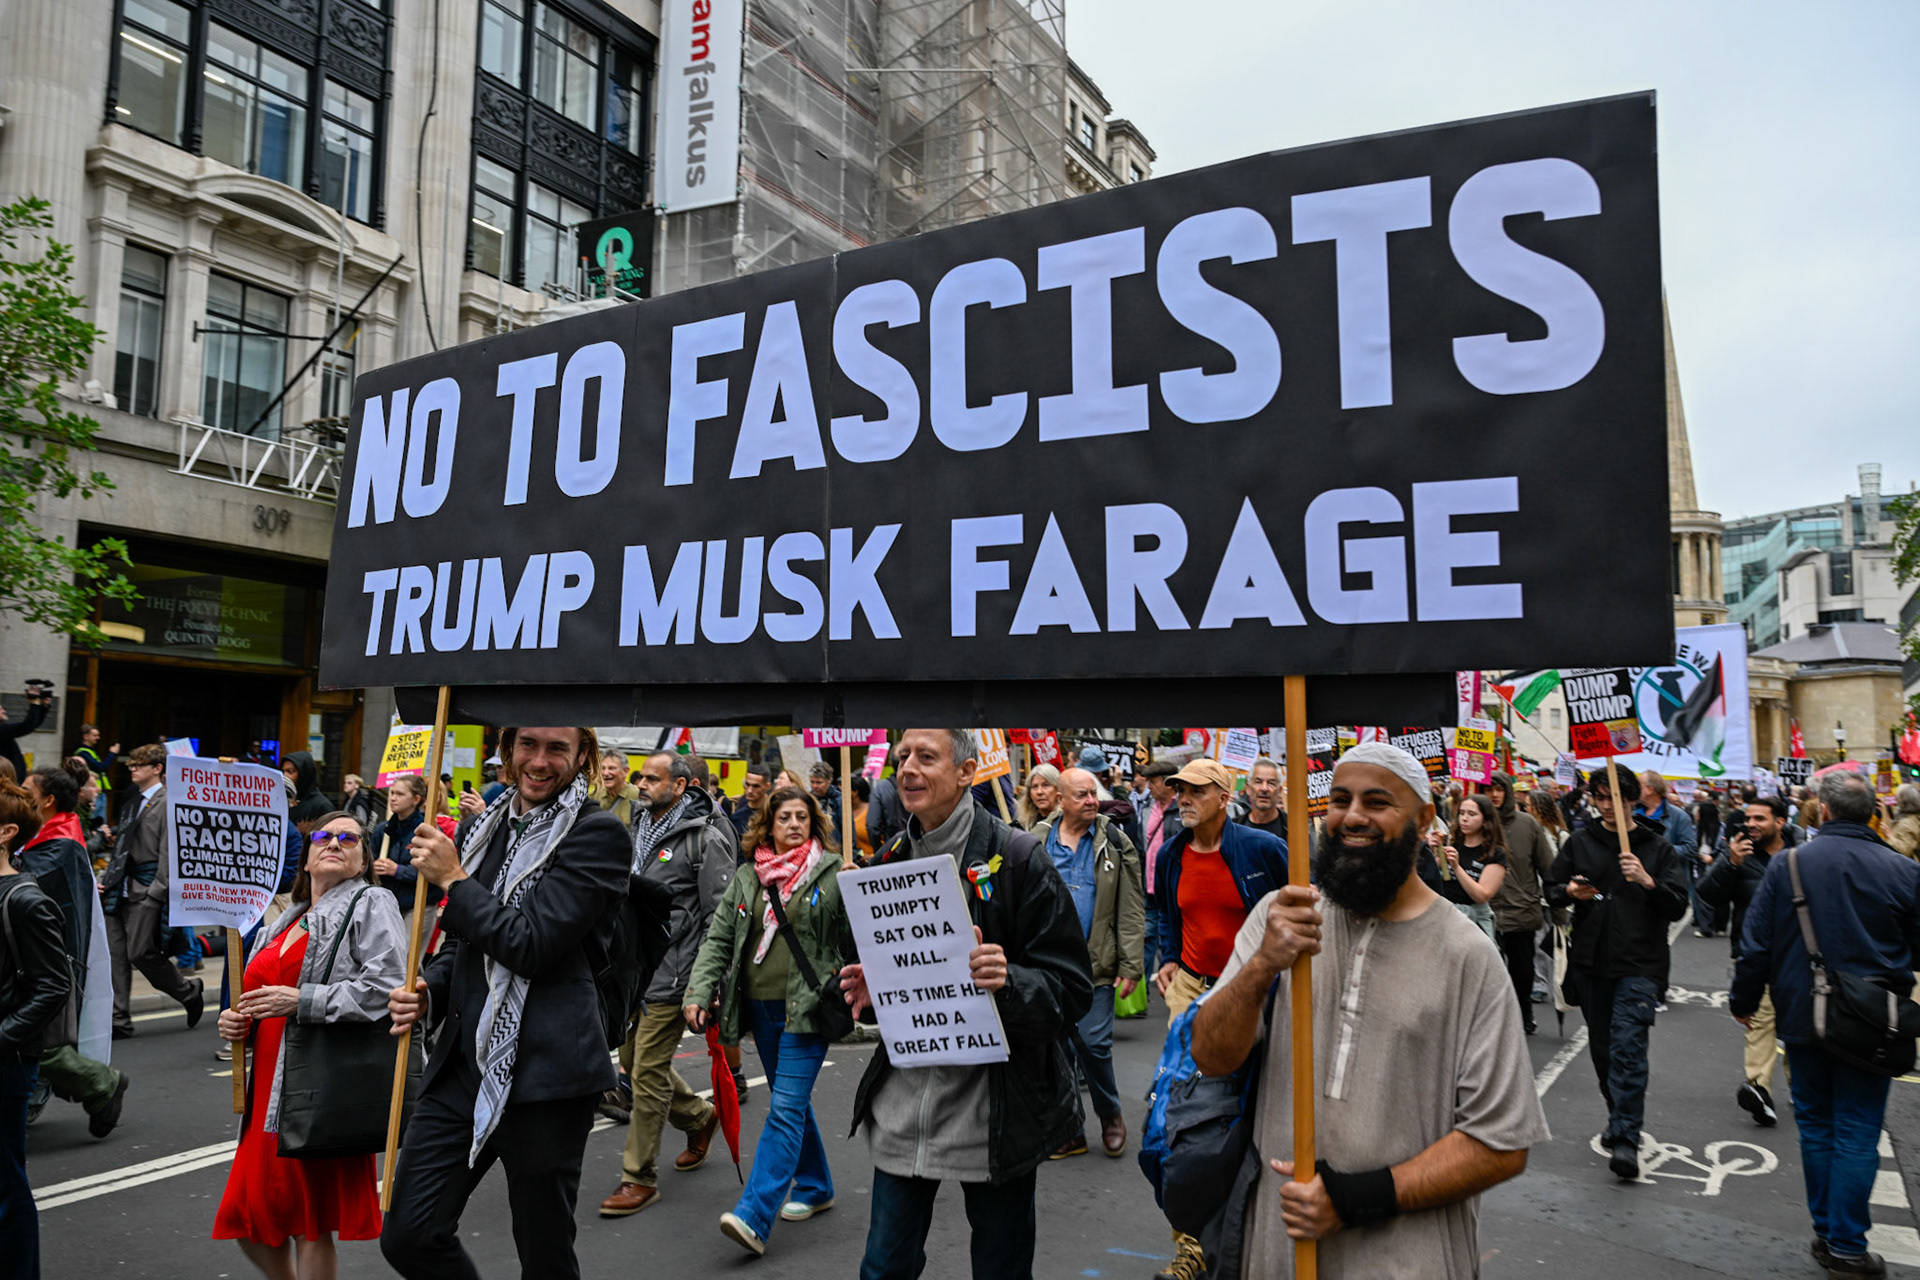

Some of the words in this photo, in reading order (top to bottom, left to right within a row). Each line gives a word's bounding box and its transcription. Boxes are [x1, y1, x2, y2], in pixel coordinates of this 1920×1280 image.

[348, 378, 460, 528] NO
[497, 341, 625, 505] TO
[664, 158, 1604, 487] FASCISTS
[253, 504, 290, 535] 309
[363, 550, 594, 656] TRUMP
[619, 524, 902, 646] MUSK
[951, 477, 1522, 636] FARAGE
[146, 595, 175, 612] THE
[178, 599, 273, 622] POLYTECHNIC
[164, 629, 216, 644] QUINTIN
[217, 635, 251, 649] HOGG
[1564, 673, 1619, 701] DUMP
[1568, 694, 1632, 723] TRUMP
[398, 733, 422, 744] STOP
[809, 728, 873, 745] TRUMP
[1459, 729, 1471, 738] NO
[1473, 730, 1483, 740] TO
[1574, 726, 1597, 739] Fight
[391, 741, 424, 753] RACIST
[1456, 750, 1469, 760] NO
[1458, 738, 1489, 751] RACISM
[386, 750, 424, 762] REFORM
[396, 761, 409, 769] UK
[1456, 759, 1468, 769] TO
[181, 767, 221, 787] FIGHT
[224, 773, 276, 792] TRUMP
[1454, 768, 1485, 781] TRUMP
[187, 785, 198, 801] &
[202, 787, 270, 808] STARMER
[176, 807, 204, 826] NO
[207, 811, 232, 828] TO
[236, 813, 281, 835] WAR
[178, 825, 279, 859] RACISM
[180, 848, 234, 865] CLIMATE
[237, 855, 277, 872] CHAOS
[181, 861, 276, 889] CAPITALISM
[858, 870, 938, 896] TRUMPTY
[182, 892, 204, 900] GIVE
[205, 893, 248, 905] STUDENTS
[183, 883, 210, 891] BUILD
[219, 887, 238, 896] NEW
[241, 889, 264, 901] PARTY
[871, 896, 940, 919] DUMPTY
[874, 927, 905, 945] SAT
[911, 923, 937, 939] ON
[943, 921, 955, 935] A
[893, 950, 948, 968] WALL.
[878, 989, 910, 1006] IT'S
[912, 984, 957, 1001] TIME
[911, 1012, 948, 1028] HAD
[954, 1010, 966, 1024] A
[894, 1036, 950, 1055] GREAT
[956, 1033, 1000, 1050] FALL
